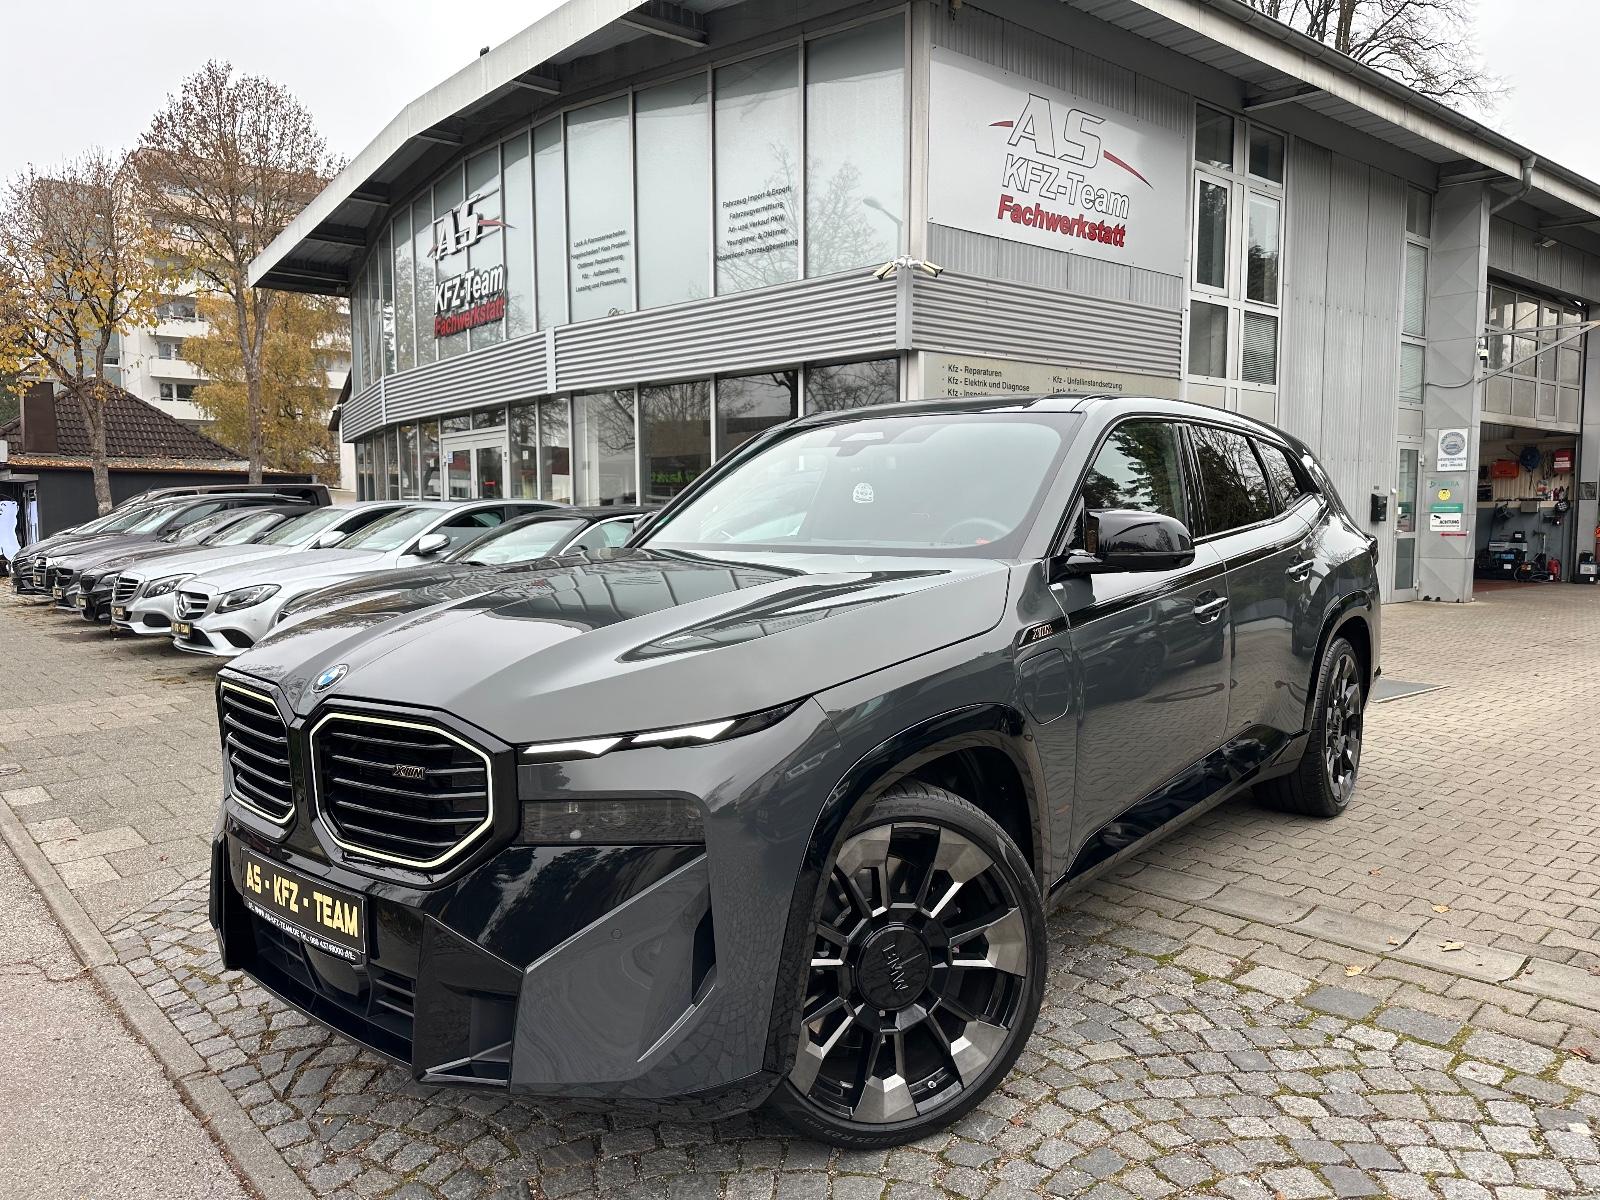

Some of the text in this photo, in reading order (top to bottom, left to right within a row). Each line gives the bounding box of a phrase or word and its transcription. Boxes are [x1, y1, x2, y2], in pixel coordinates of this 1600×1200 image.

[1007, 93, 1106, 169] AS
[722, 198, 746, 208] Fahrzeug
[748, 193, 765, 203] Import
[1002, 153, 1130, 219] KFZ-Team
[435, 194, 481, 260] AS
[998, 194, 1126, 247] Fachwerkstatt
[434, 264, 504, 314] KFZ-Team
[433, 295, 505, 338] Fachwerkstatt
[948, 364, 958, 372] Kfz
[964, 366, 1002, 377] Reparaturen
[948, 388, 958, 396] Kfz
[964, 378, 988, 388] Elektrik
[1002, 382, 1030, 392] Diagnose
[246, 861, 262, 894] AS
[274, 874, 298, 914] KFZ
[313, 891, 358, 938] TEAM
